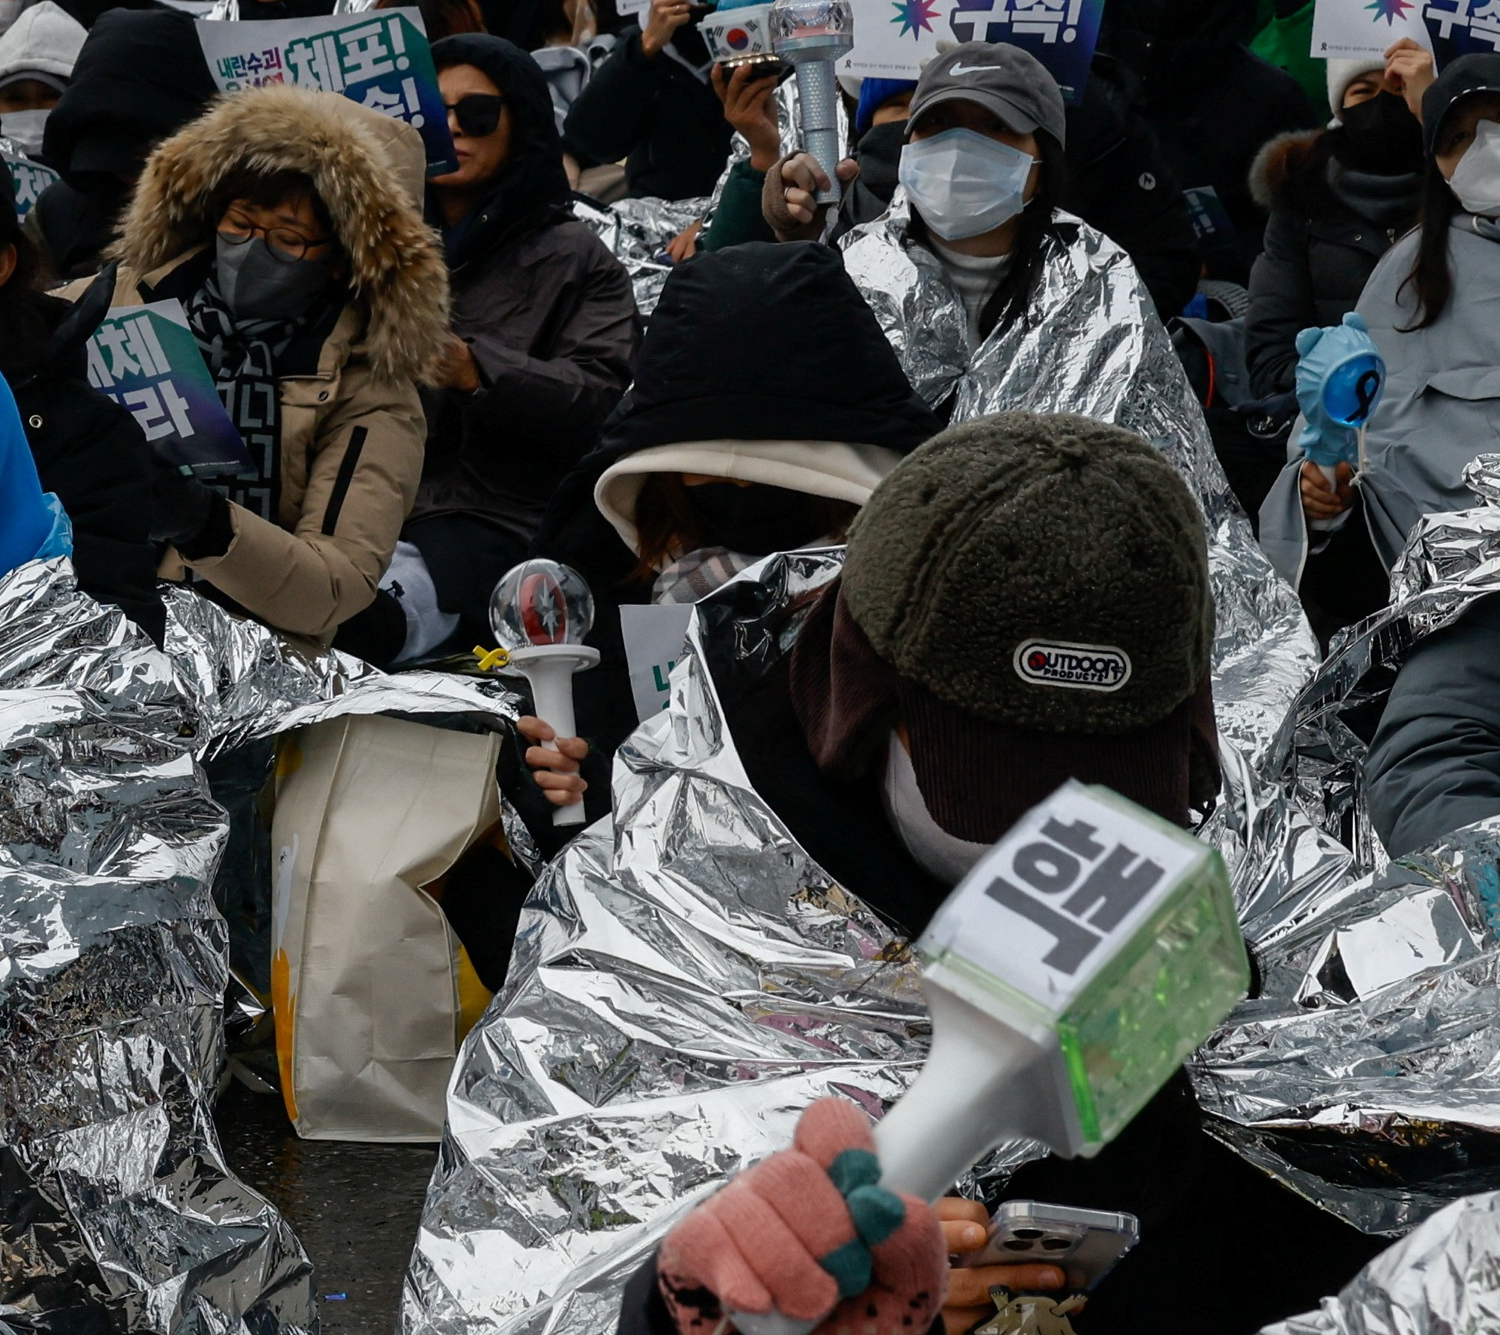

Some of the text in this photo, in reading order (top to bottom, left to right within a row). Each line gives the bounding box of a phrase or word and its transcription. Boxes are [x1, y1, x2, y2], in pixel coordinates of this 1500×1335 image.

[216, 45, 282, 80] 내란수괴
[284, 19, 410, 95] 체포!
[1028, 651, 1122, 680] OUTDOOR
[1044, 667, 1105, 682] PRODUCTS
[984, 814, 1167, 977] 핵
